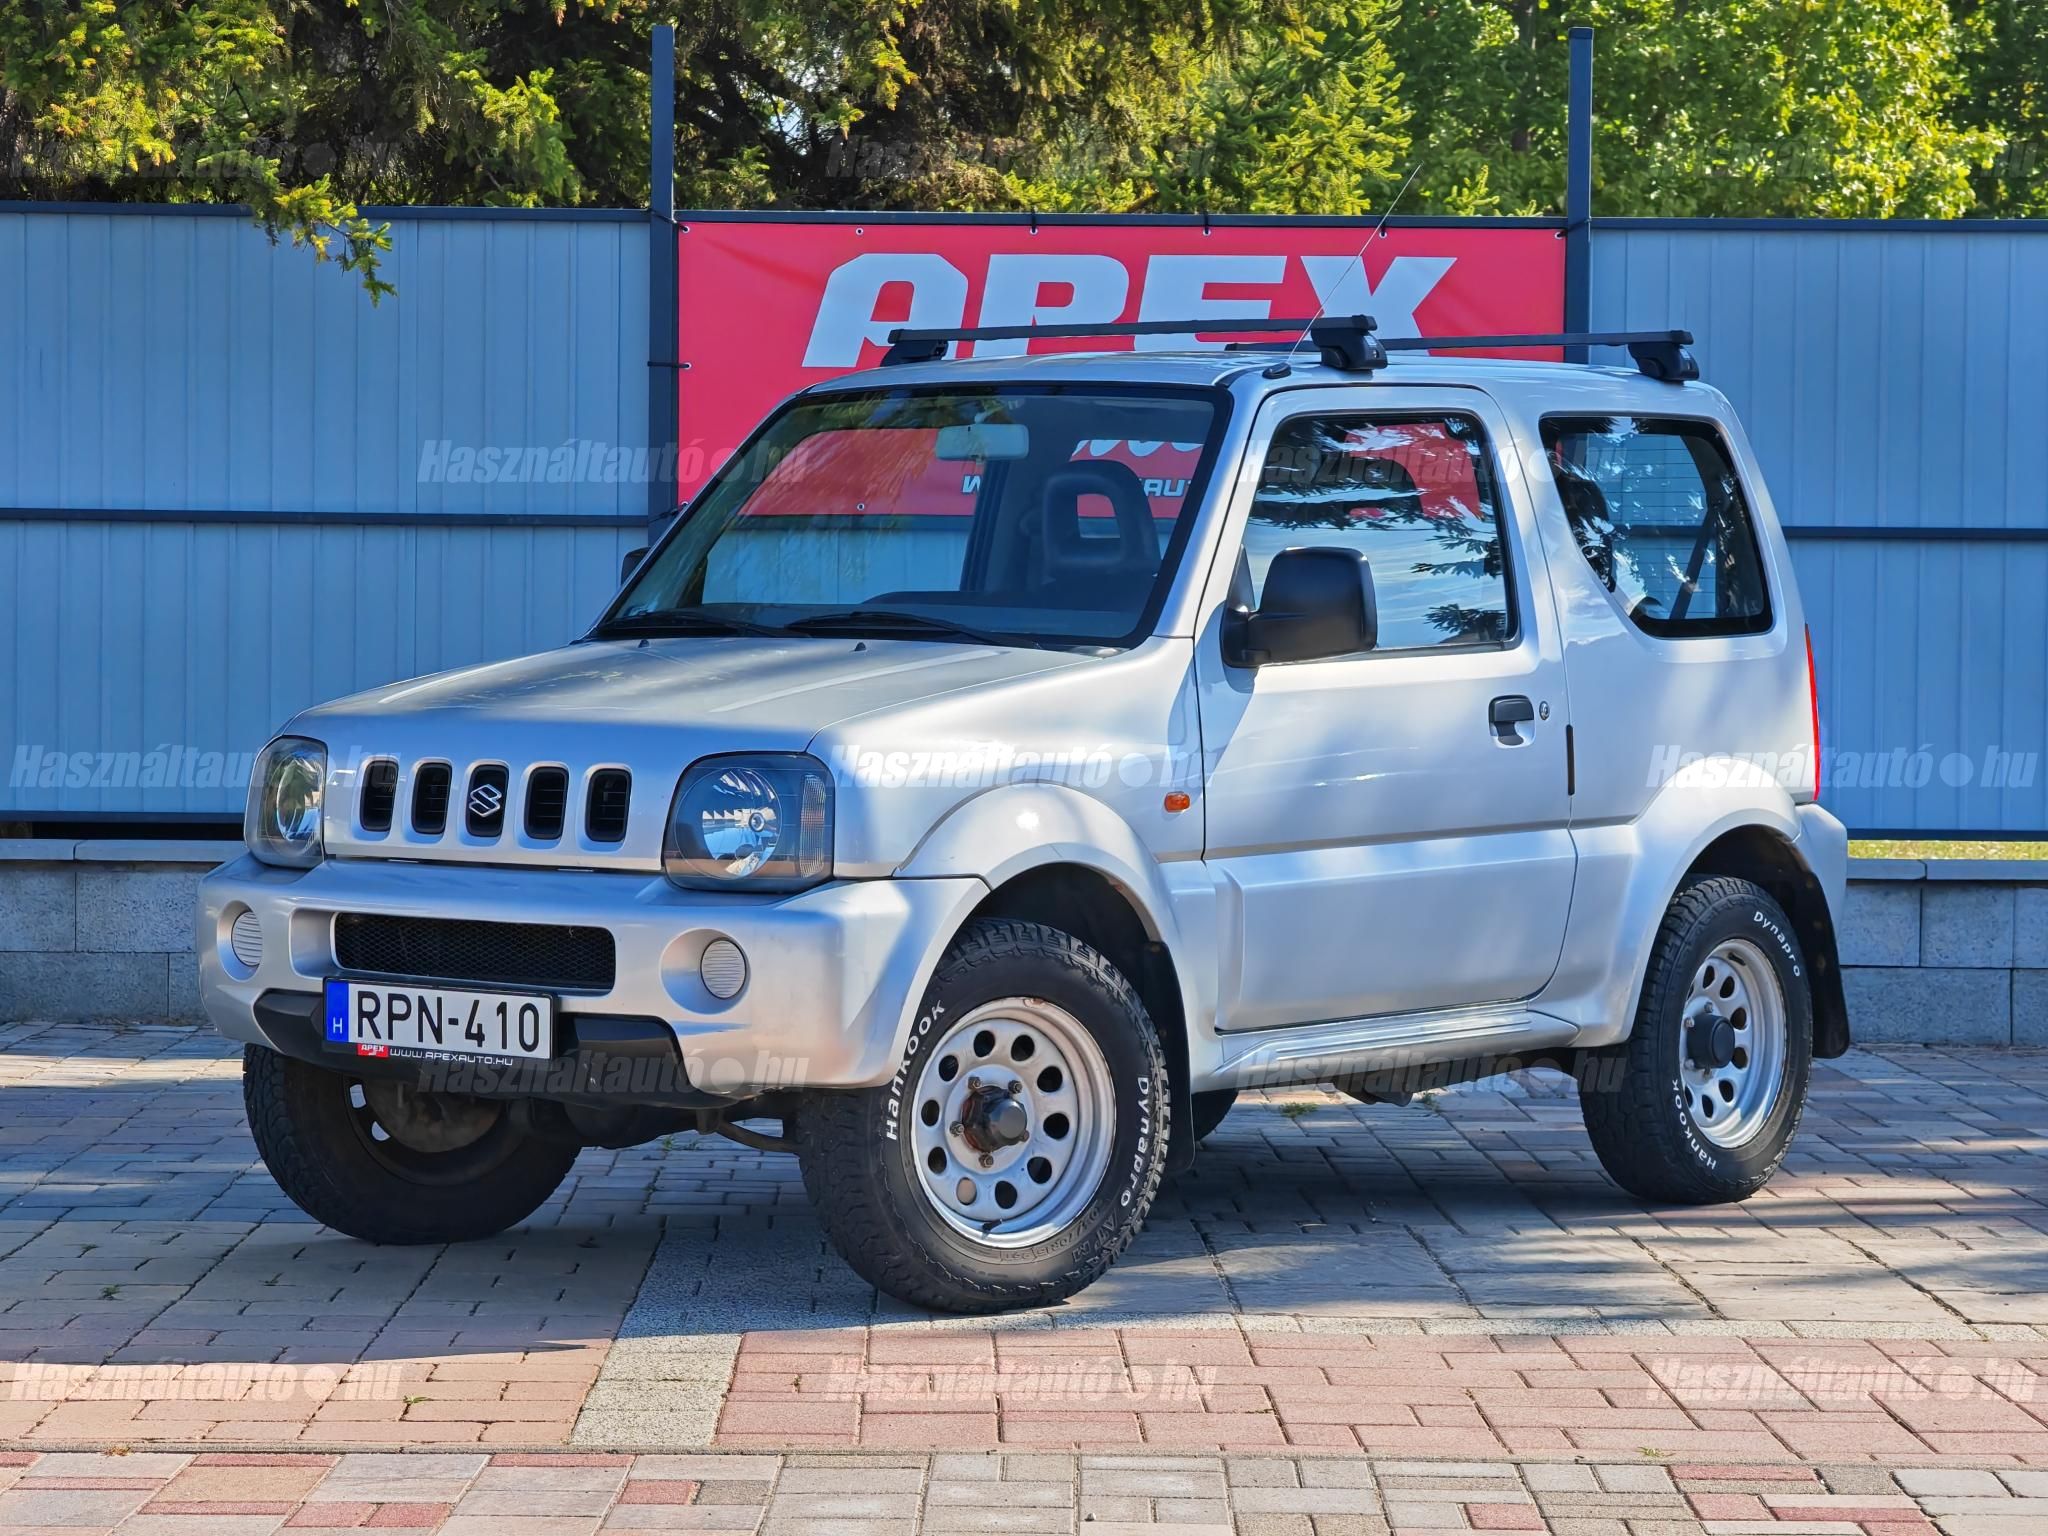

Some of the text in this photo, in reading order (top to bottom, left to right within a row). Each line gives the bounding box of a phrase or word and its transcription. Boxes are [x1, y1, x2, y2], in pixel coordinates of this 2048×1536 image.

[802, 252, 1457, 368] APEX
[1754, 911, 1800, 977] Dynapro
[333, 1017, 343, 1034] H
[357, 990, 540, 1053] RPN-410
[361, 1044, 514, 1066] APEX WWW.APEXAUTO.HU
[886, 1000, 946, 1141] Hankook
[1120, 1077, 1150, 1207] Dynapro
[1672, 1079, 1716, 1170] Hankook
